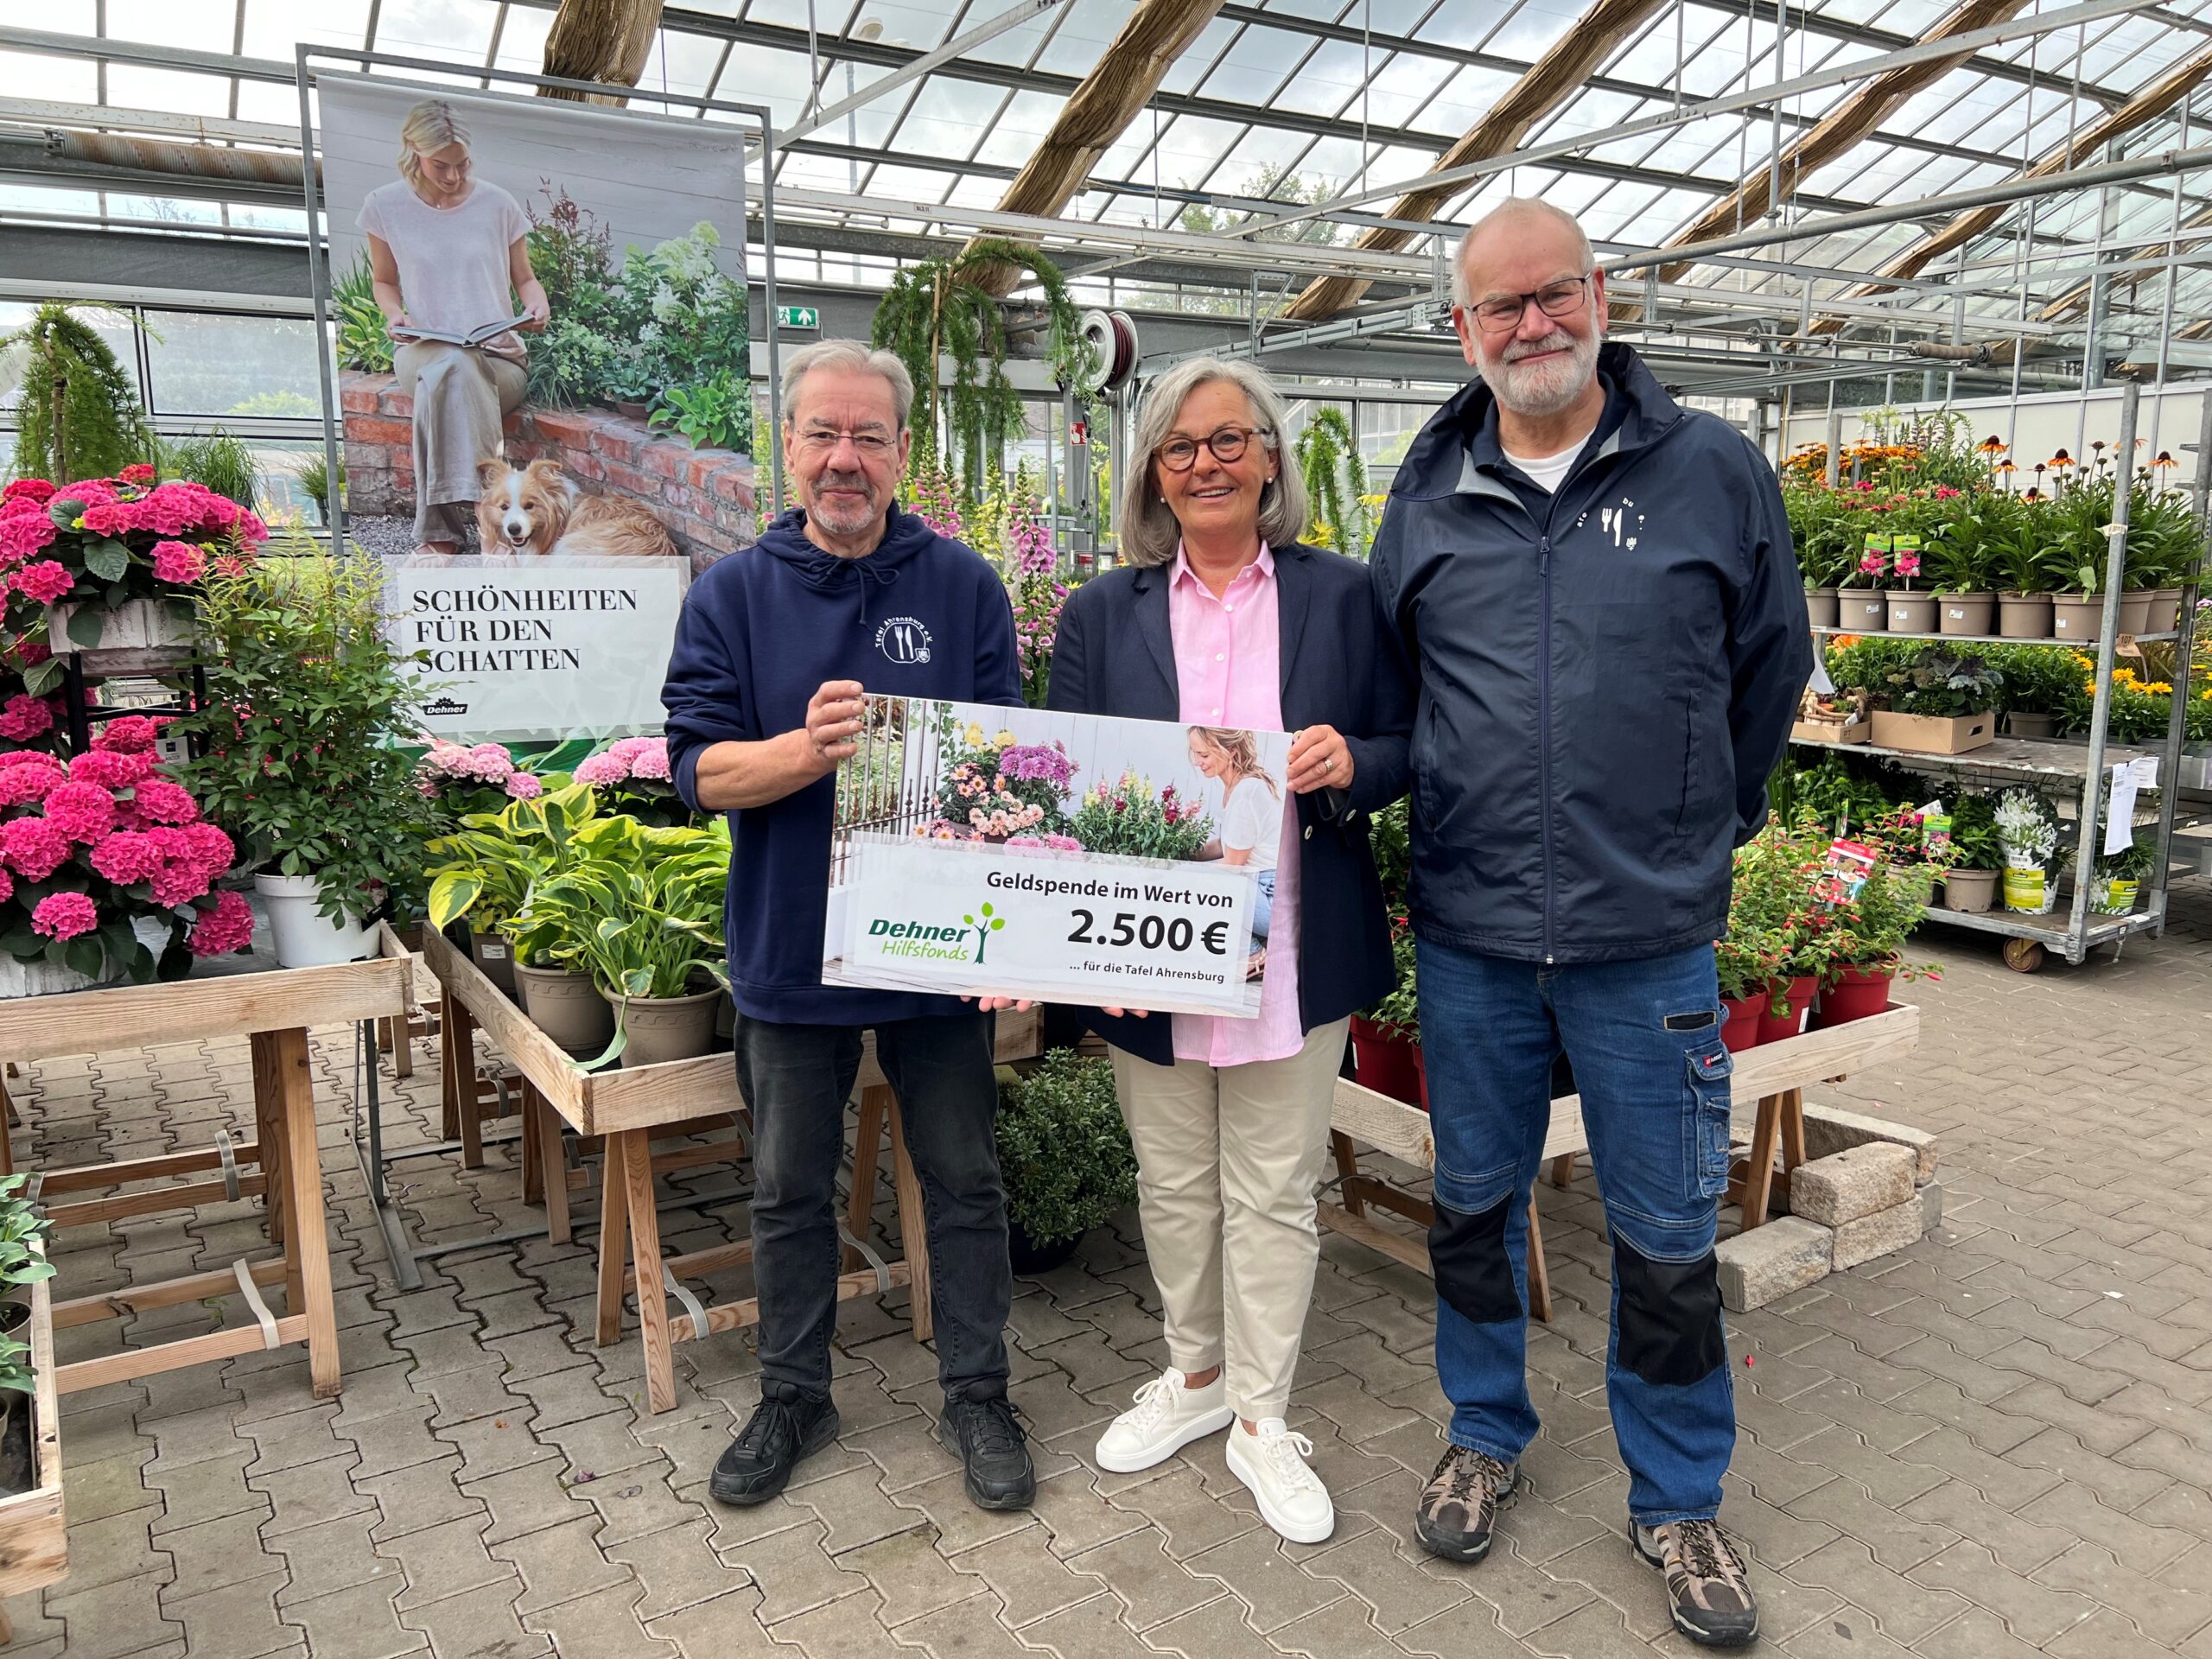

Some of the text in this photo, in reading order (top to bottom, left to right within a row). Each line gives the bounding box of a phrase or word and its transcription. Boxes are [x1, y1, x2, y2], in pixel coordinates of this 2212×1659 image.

[413, 584, 638, 612] SCHÖNHEITEN
[415, 615, 552, 642] FÜR DEN
[416, 648, 581, 673] SCHATTEN
[426, 705, 466, 715] Dehner
[987, 871, 1233, 908] Geldspende im Wert von
[868, 918, 971, 943] Dehner
[881, 940, 969, 961] Hilfsfonds
[1084, 960, 1101, 972] für
[1103, 963, 1122, 974] die
[1125, 964, 1153, 976] Tafel
[1156, 967, 1224, 985] Ahrensburg
